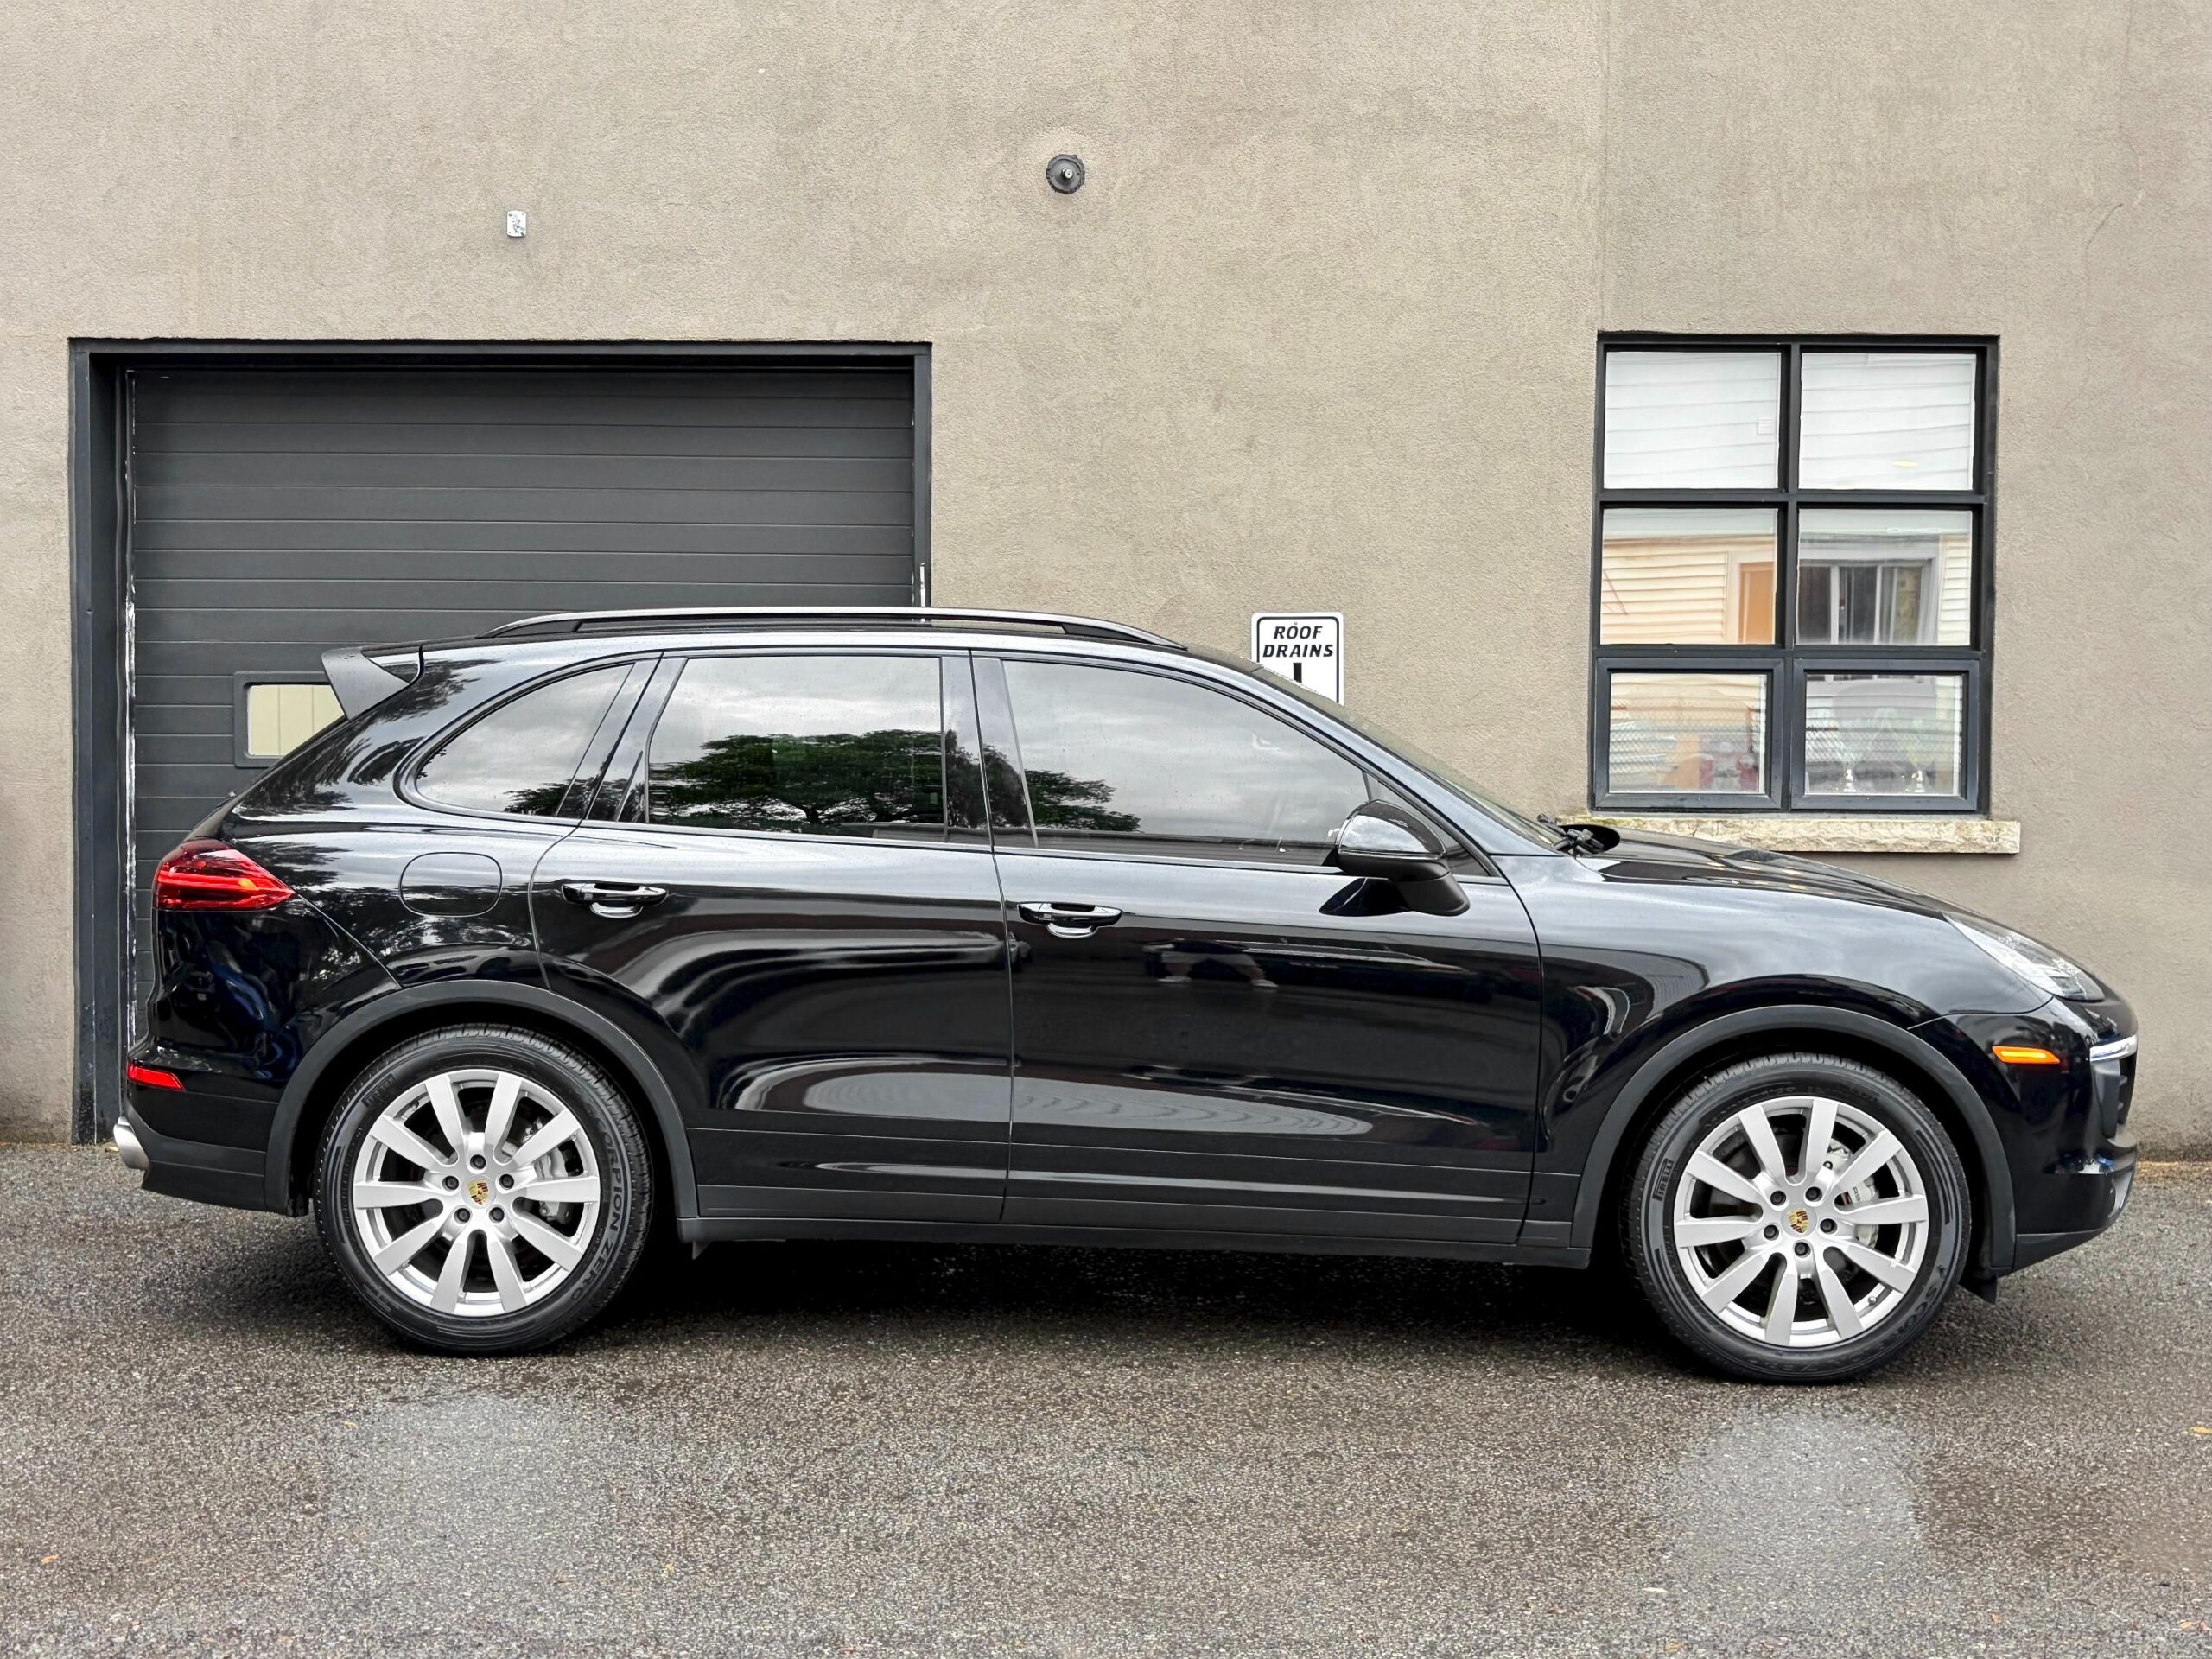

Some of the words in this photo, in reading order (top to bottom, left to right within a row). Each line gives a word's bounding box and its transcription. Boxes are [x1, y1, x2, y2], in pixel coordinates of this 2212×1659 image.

[1273, 626, 1323, 639] ROOF
[1262, 644, 1334, 658] DRAINS
[570, 1238, 614, 1300] ZERO
